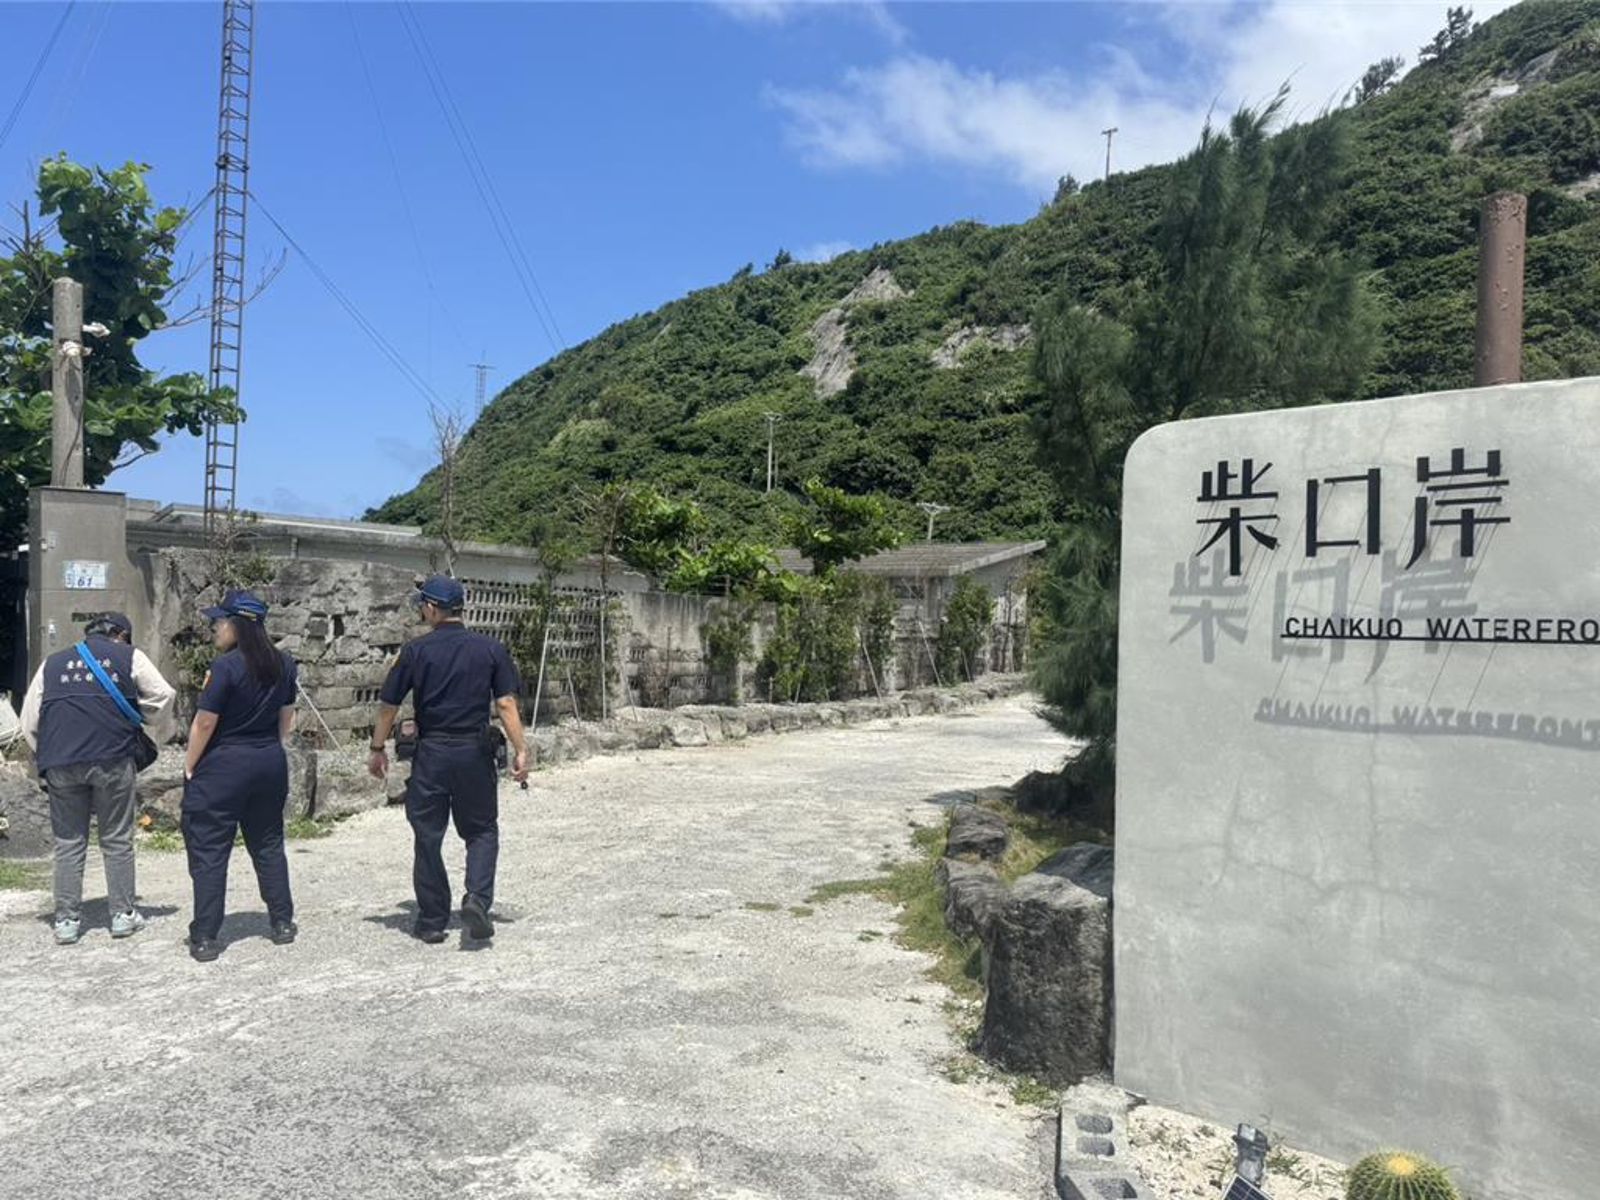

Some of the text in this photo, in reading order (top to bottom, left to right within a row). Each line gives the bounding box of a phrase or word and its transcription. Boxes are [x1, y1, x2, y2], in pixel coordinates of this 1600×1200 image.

[1196, 448, 1511, 576] 柴口岸
[1285, 617, 1600, 643] CHAIKUO WATERFRO
